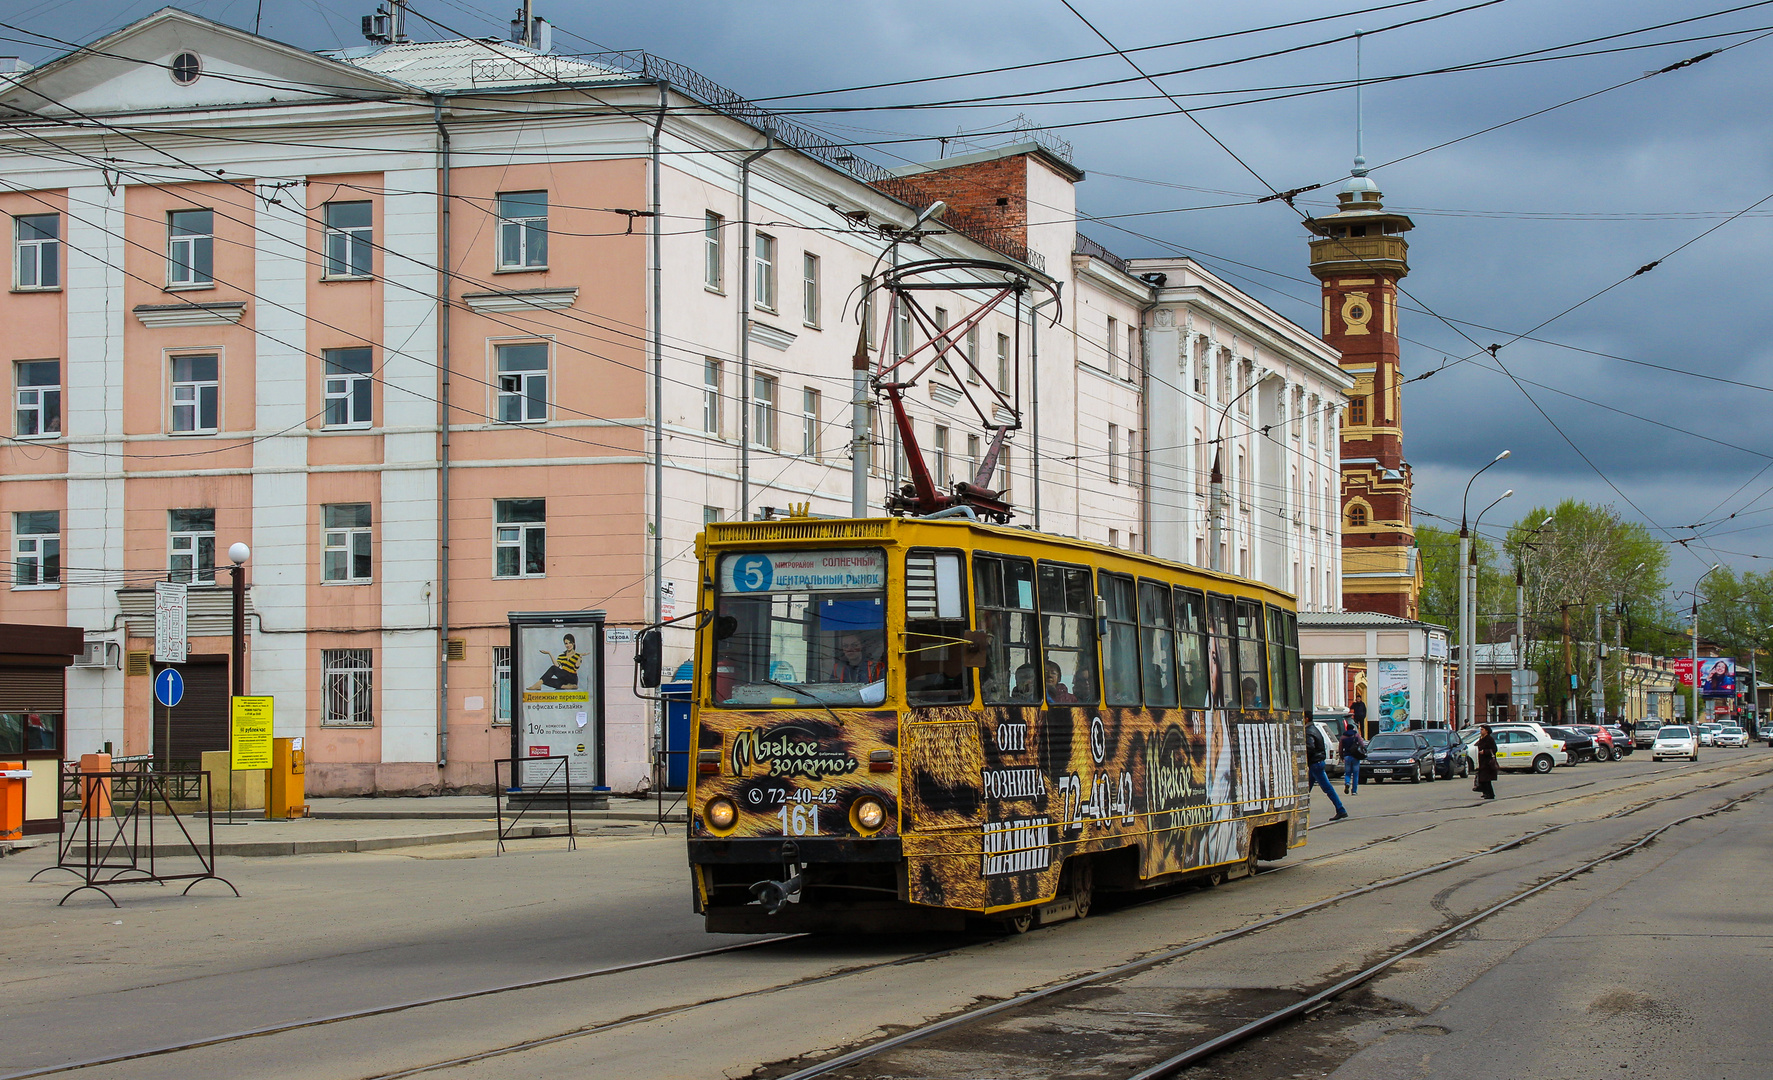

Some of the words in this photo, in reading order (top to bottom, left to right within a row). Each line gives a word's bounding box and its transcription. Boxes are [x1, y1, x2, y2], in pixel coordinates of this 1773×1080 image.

[744, 561, 764, 590] 5
[775, 561, 814, 569] МИКРОРАЙОН
[822, 557, 876, 568] СОЛНЕЧНЫЙ
[776, 574, 843, 586] ЦЕНТРАЛЬНЫЙ
[846, 574, 879, 585] РЫНОК
[527, 694, 558, 702] Денежные
[528, 723, 544, 735] 1%
[997, 723, 1026, 751] ОПТ
[732, 729, 818, 776] Мягкое
[1237, 722, 1295, 812] ШУБЫ
[983, 768, 1046, 801] РОЗНИЦА
[1146, 729, 1193, 830] Мягкое
[767, 788, 837, 804] 72-40-42
[1059, 772, 1135, 831] 72-40-42
[777, 804, 819, 836] 161
[983, 818, 1049, 875] ШАПКИ
